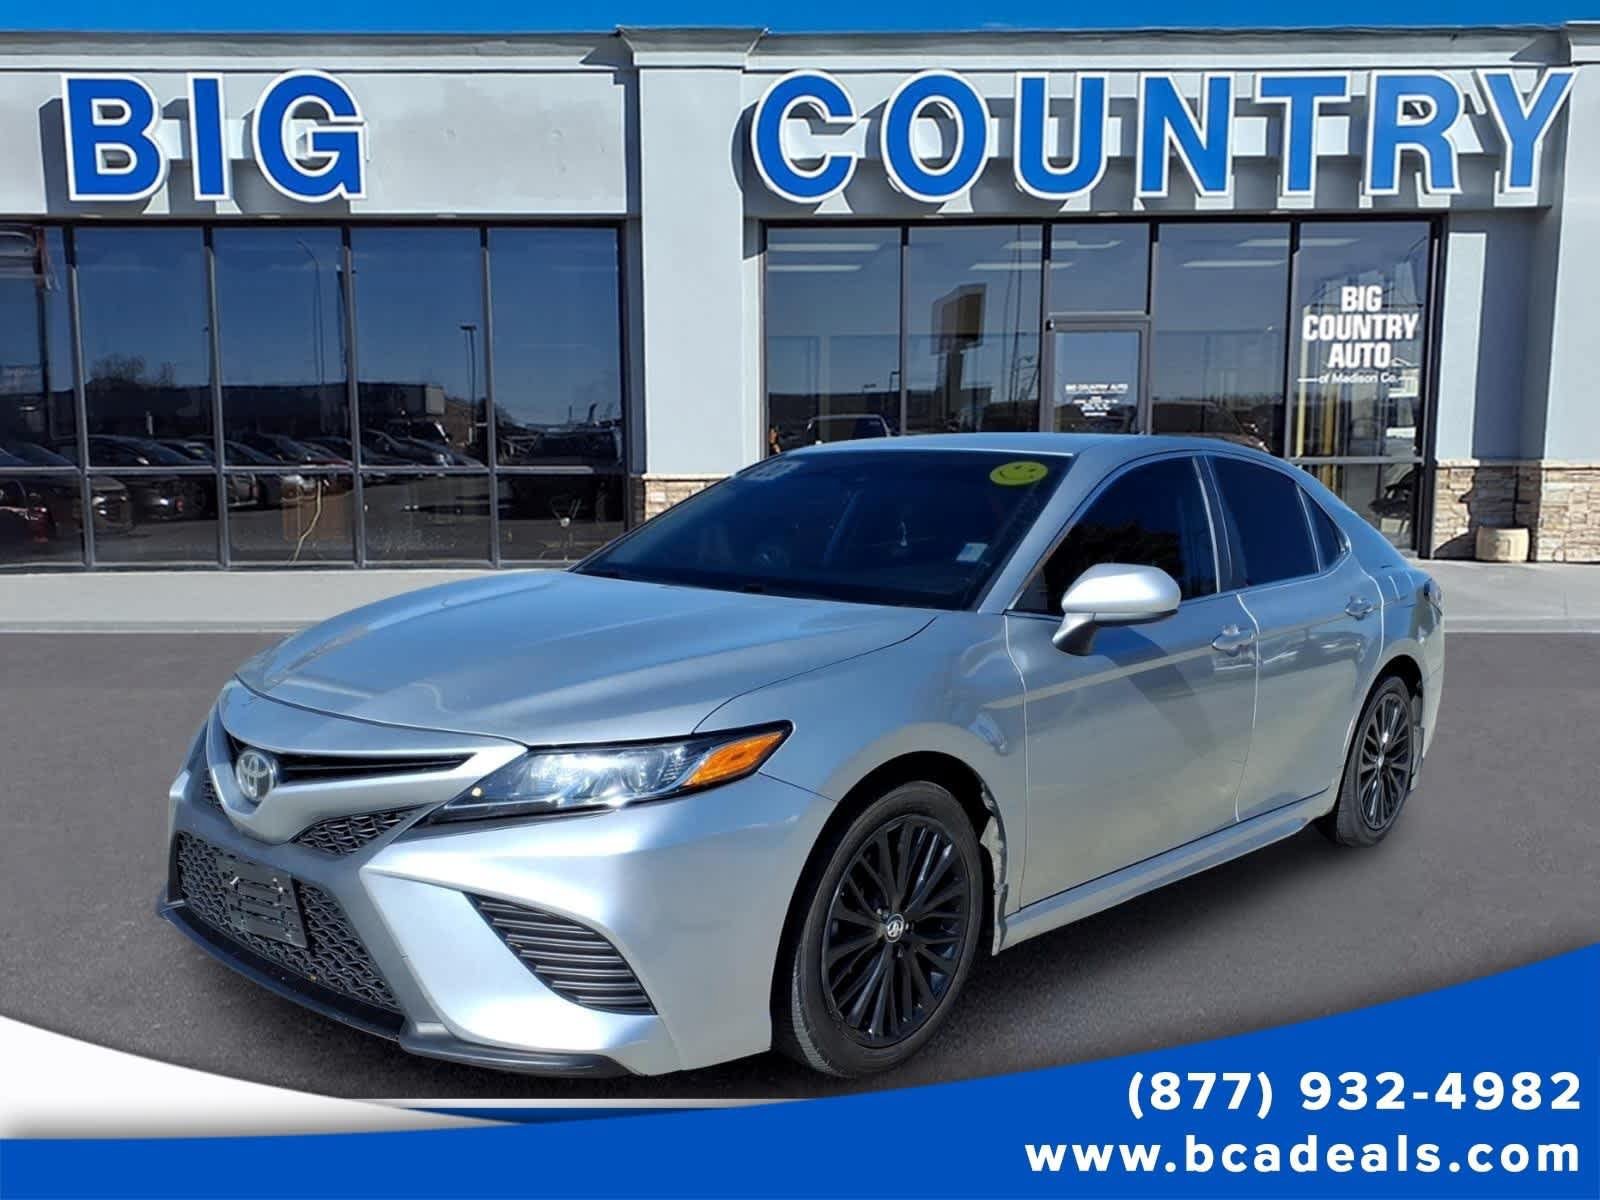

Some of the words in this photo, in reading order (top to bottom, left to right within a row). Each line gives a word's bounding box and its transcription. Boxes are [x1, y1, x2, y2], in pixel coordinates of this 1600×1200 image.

[61, 70, 368, 202] BIG
[751, 69, 1574, 203] COUNTRY
[1341, 285, 1382, 312] BIG
[1302, 313, 1419, 340] COUNTRY
[1327, 342, 1391, 369] AUTO
[1319, 372, 1330, 384] of
[1331, 372, 1379, 384] Madison
